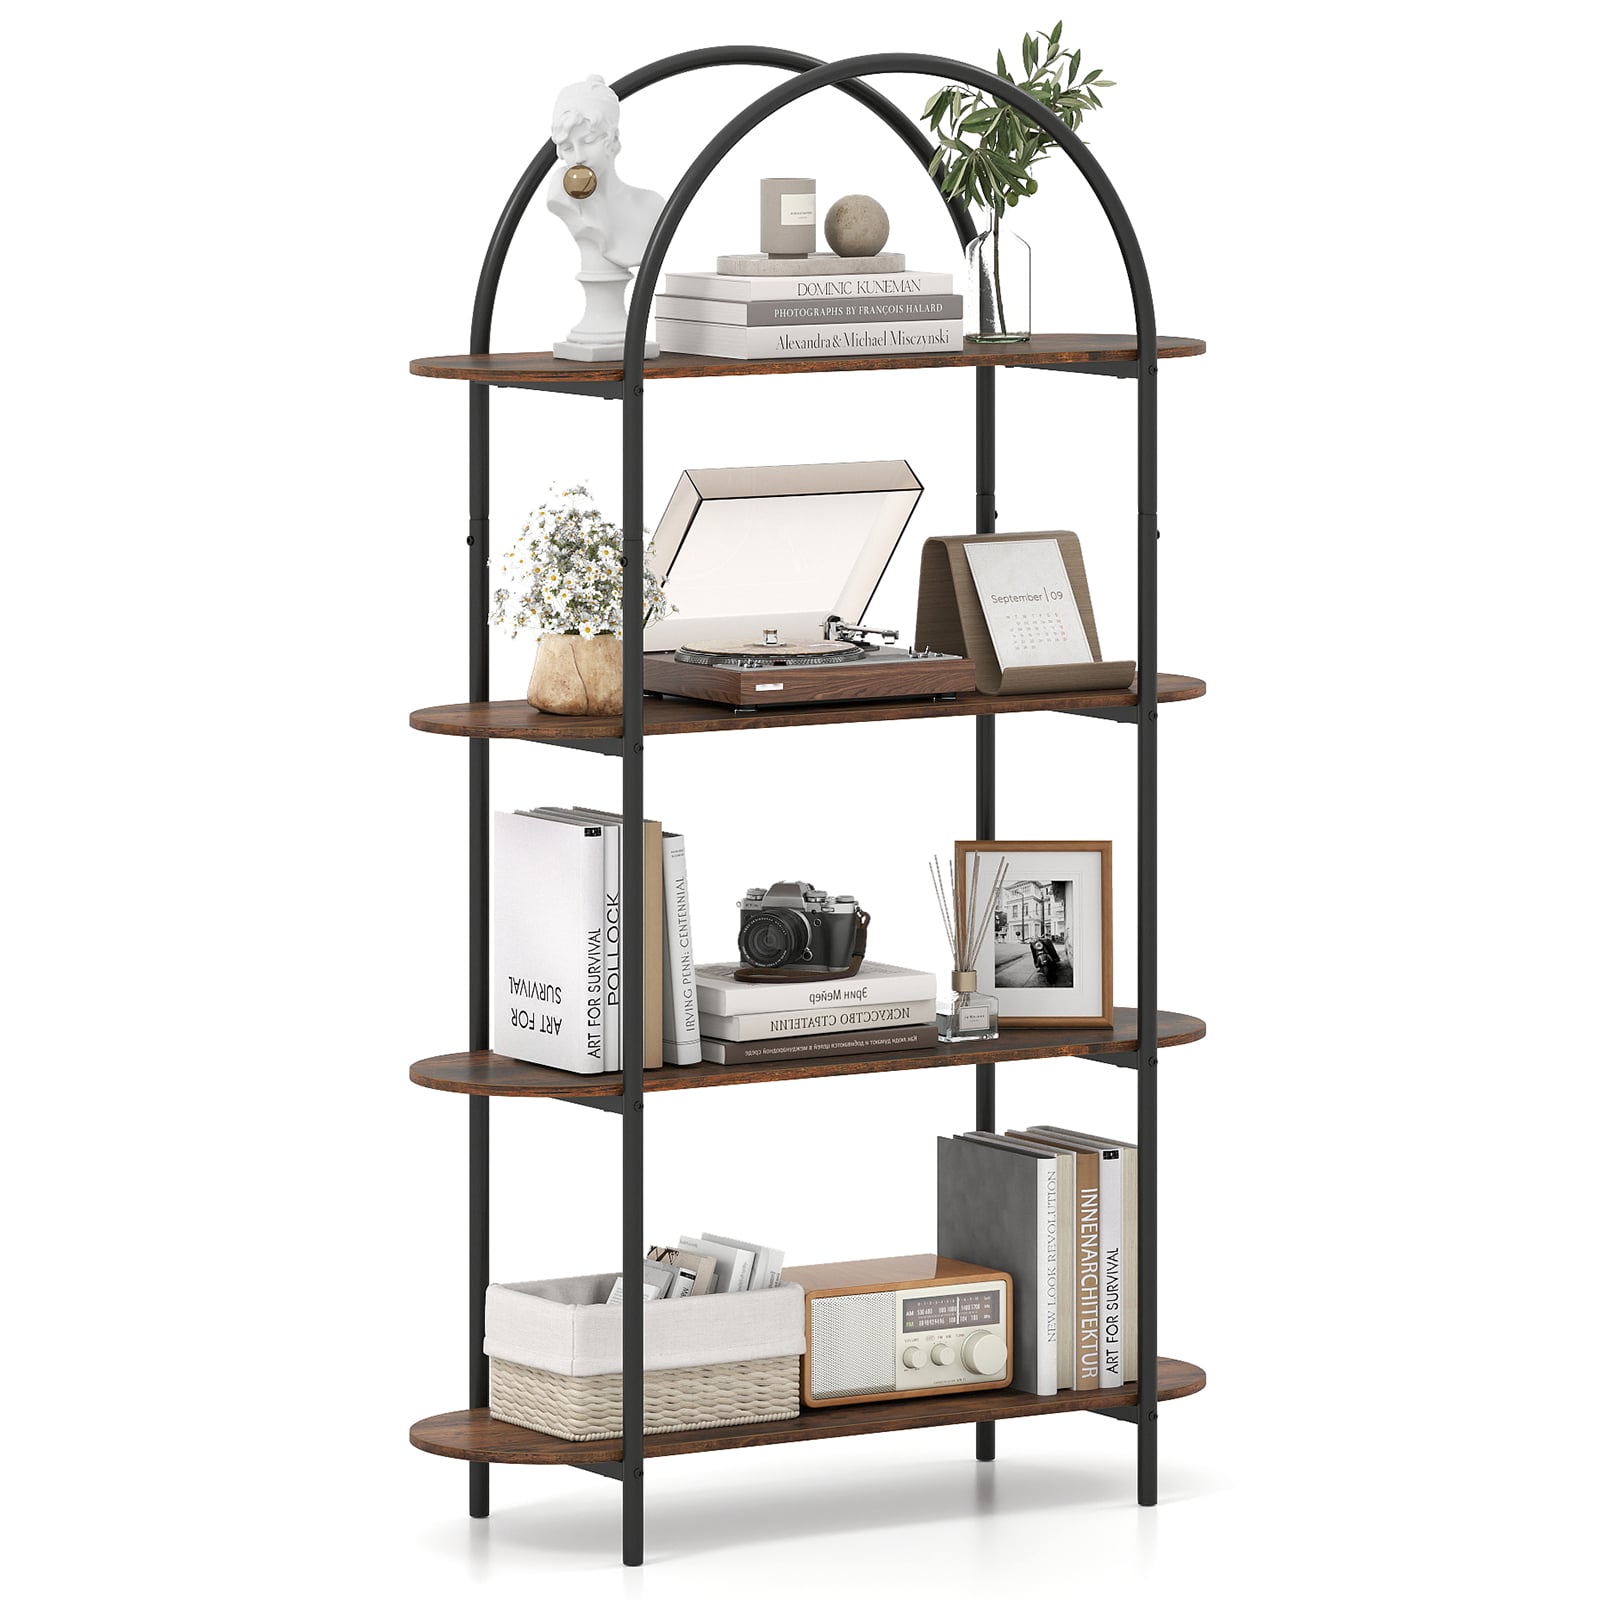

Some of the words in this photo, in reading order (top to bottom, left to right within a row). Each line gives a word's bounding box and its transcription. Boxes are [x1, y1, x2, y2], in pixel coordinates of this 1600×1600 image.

[798, 281, 852, 296] DOMINIC
[858, 279, 920, 294] KUNEMAN
[774, 307, 843, 318] PHOTOGRAPHS
[846, 306, 856, 315] BY
[859, 305, 904, 317] FRANÇOIS
[906, 304, 943, 313] HALARD
[778, 334, 831, 350] Alexandra
[832, 336, 841, 347] &
[843, 331, 888, 347] Michael
[890, 329, 949, 347] Misczynski
[991, 593, 1042, 604] September
[1051, 591, 1063, 600] 09
[677, 876, 689, 947] CENTENNIAL
[588, 928, 601, 992] SURVIVAL
[607, 894, 619, 1006] POLLOCK
[681, 951, 692, 984] PENN:
[508, 977, 562, 1004] SURVIVAL
[511, 1008, 535, 1030] FOR
[588, 998, 601, 1027] FOR
[684, 989, 694, 1031] IRVING
[540, 1015, 562, 1036] ART
[588, 1033, 600, 1058] ART
[1047, 1170, 1056, 1265] REVOLUTION
[1047, 1267, 1056, 1307] LOOK
[1080, 1187, 1098, 1379] INNENARCHITEKTUR
[1106, 1248, 1118, 1310] SURVIVAL
[1048, 1309, 1056, 1343] NEW
[1106, 1315, 1118, 1342] FOR
[1106, 1350, 1118, 1374] ART
